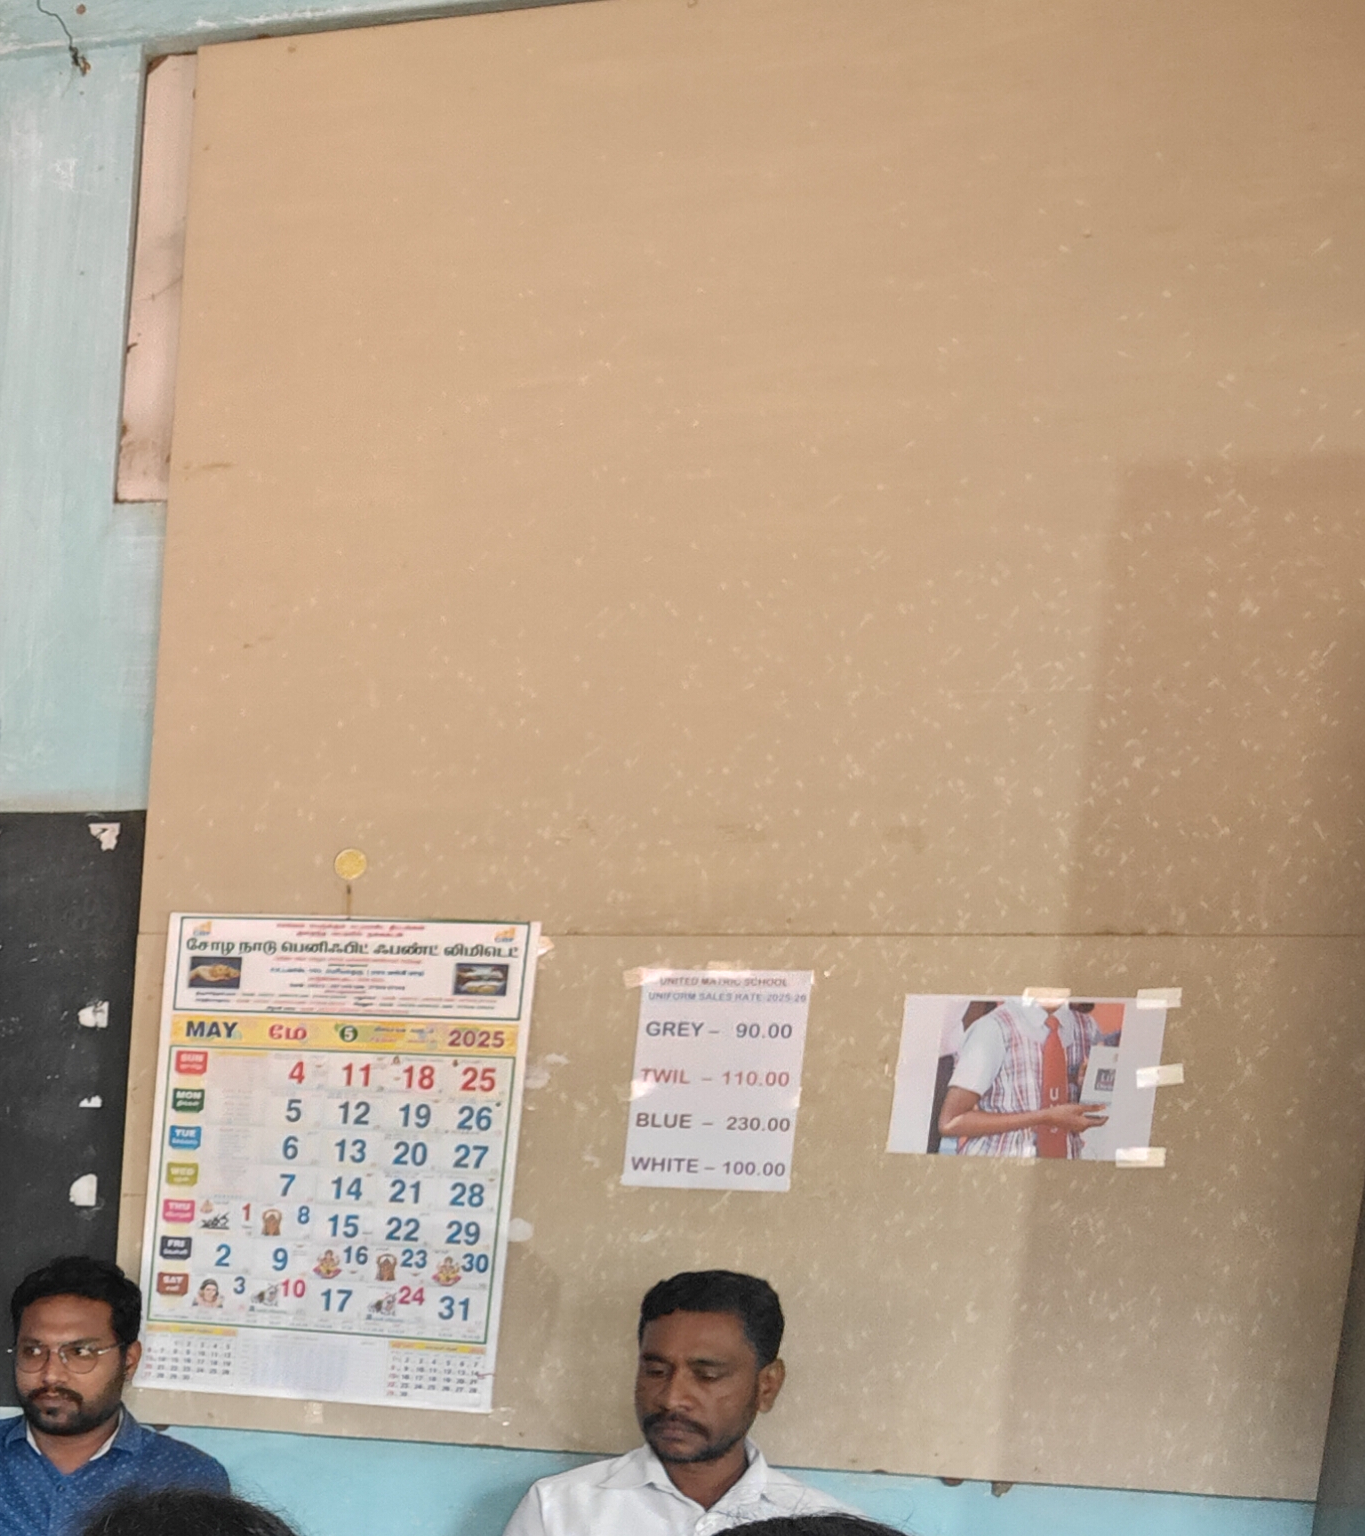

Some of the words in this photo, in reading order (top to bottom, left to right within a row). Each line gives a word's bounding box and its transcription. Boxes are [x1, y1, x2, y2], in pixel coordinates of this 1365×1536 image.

[660, 976, 698, 987] UNITED
[744, 978, 787, 988] SCHOOL
[185, 1021, 238, 1039] MAY
[269, 1024, 308, 1040] மே
[344, 1027, 354, 1041] 5
[448, 1029, 506, 1048] 2025
[645, 1021, 704, 1037] GREY
[736, 1023, 793, 1039] 90.00
[288, 1061, 305, 1084] 4
[342, 1063, 371, 1087] 11
[403, 1065, 435, 1090] 18
[460, 1067, 497, 1092] 25
[640, 1068, 690, 1084] TWIL
[722, 1071, 790, 1087] 110.00
[285, 1099, 302, 1122] 5
[338, 1101, 371, 1125] 12
[399, 1103, 431, 1128] 19
[457, 1105, 493, 1131] 26
[635, 1113, 692, 1129] BLUE
[726, 1116, 791, 1132] 230.00
[282, 1135, 299, 1160] 6
[334, 1139, 367, 1163] 13
[392, 1141, 428, 1166] 20
[453, 1144, 489, 1169] 27
[631, 1156, 699, 1174] WHITE
[722, 1161, 786, 1177] 100.00
[279, 1173, 296, 1197] 7
[331, 1176, 363, 1201] 14
[389, 1179, 421, 1204] 21
[449, 1182, 485, 1208] 28
[242, 1203, 251, 1221] 1
[297, 1205, 310, 1225] 8
[328, 1214, 360, 1239] 15
[385, 1217, 420, 1242] 22
[445, 1220, 481, 1246] 29
[214, 1243, 232, 1267] 2
[272, 1247, 288, 1271] 9
[343, 1245, 369, 1265] 16
[400, 1248, 428, 1269] 23
[461, 1252, 489, 1273] 30
[233, 1276, 246, 1295] 3
[281, 1278, 306, 1298] 10
[321, 1288, 353, 1312] 17
[398, 1285, 425, 1306] 24
[438, 1295, 470, 1321] 31
